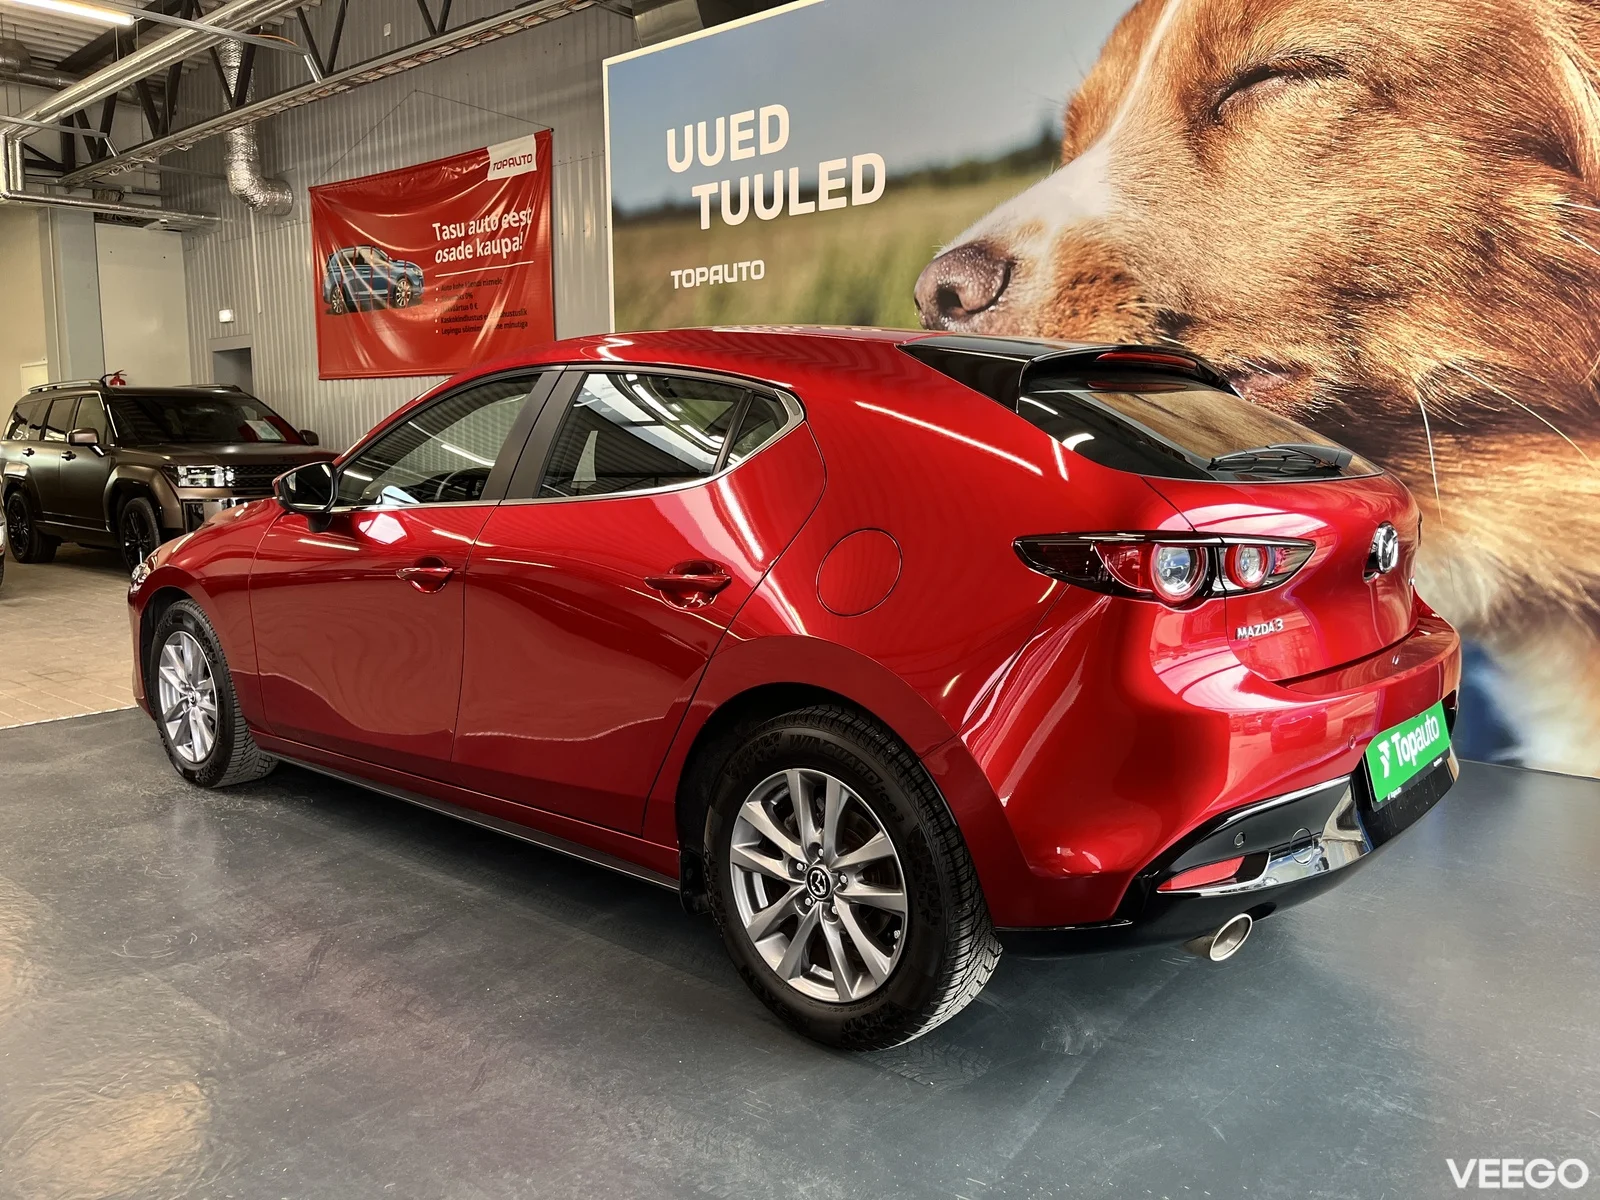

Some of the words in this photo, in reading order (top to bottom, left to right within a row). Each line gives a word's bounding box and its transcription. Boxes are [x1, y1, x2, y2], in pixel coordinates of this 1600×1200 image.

[666, 104, 790, 173] UUED
[493, 153, 533, 171] TOPAUTO
[691, 152, 886, 230] TUULED
[432, 222, 465, 241] Tasu
[468, 214, 499, 236] auto
[501, 207, 532, 229] eest
[435, 241, 473, 263] osade
[476, 232, 523, 259] kaupa!
[670, 259, 765, 290] TOPAUTO
[1391, 713, 1440, 767] Topauto
